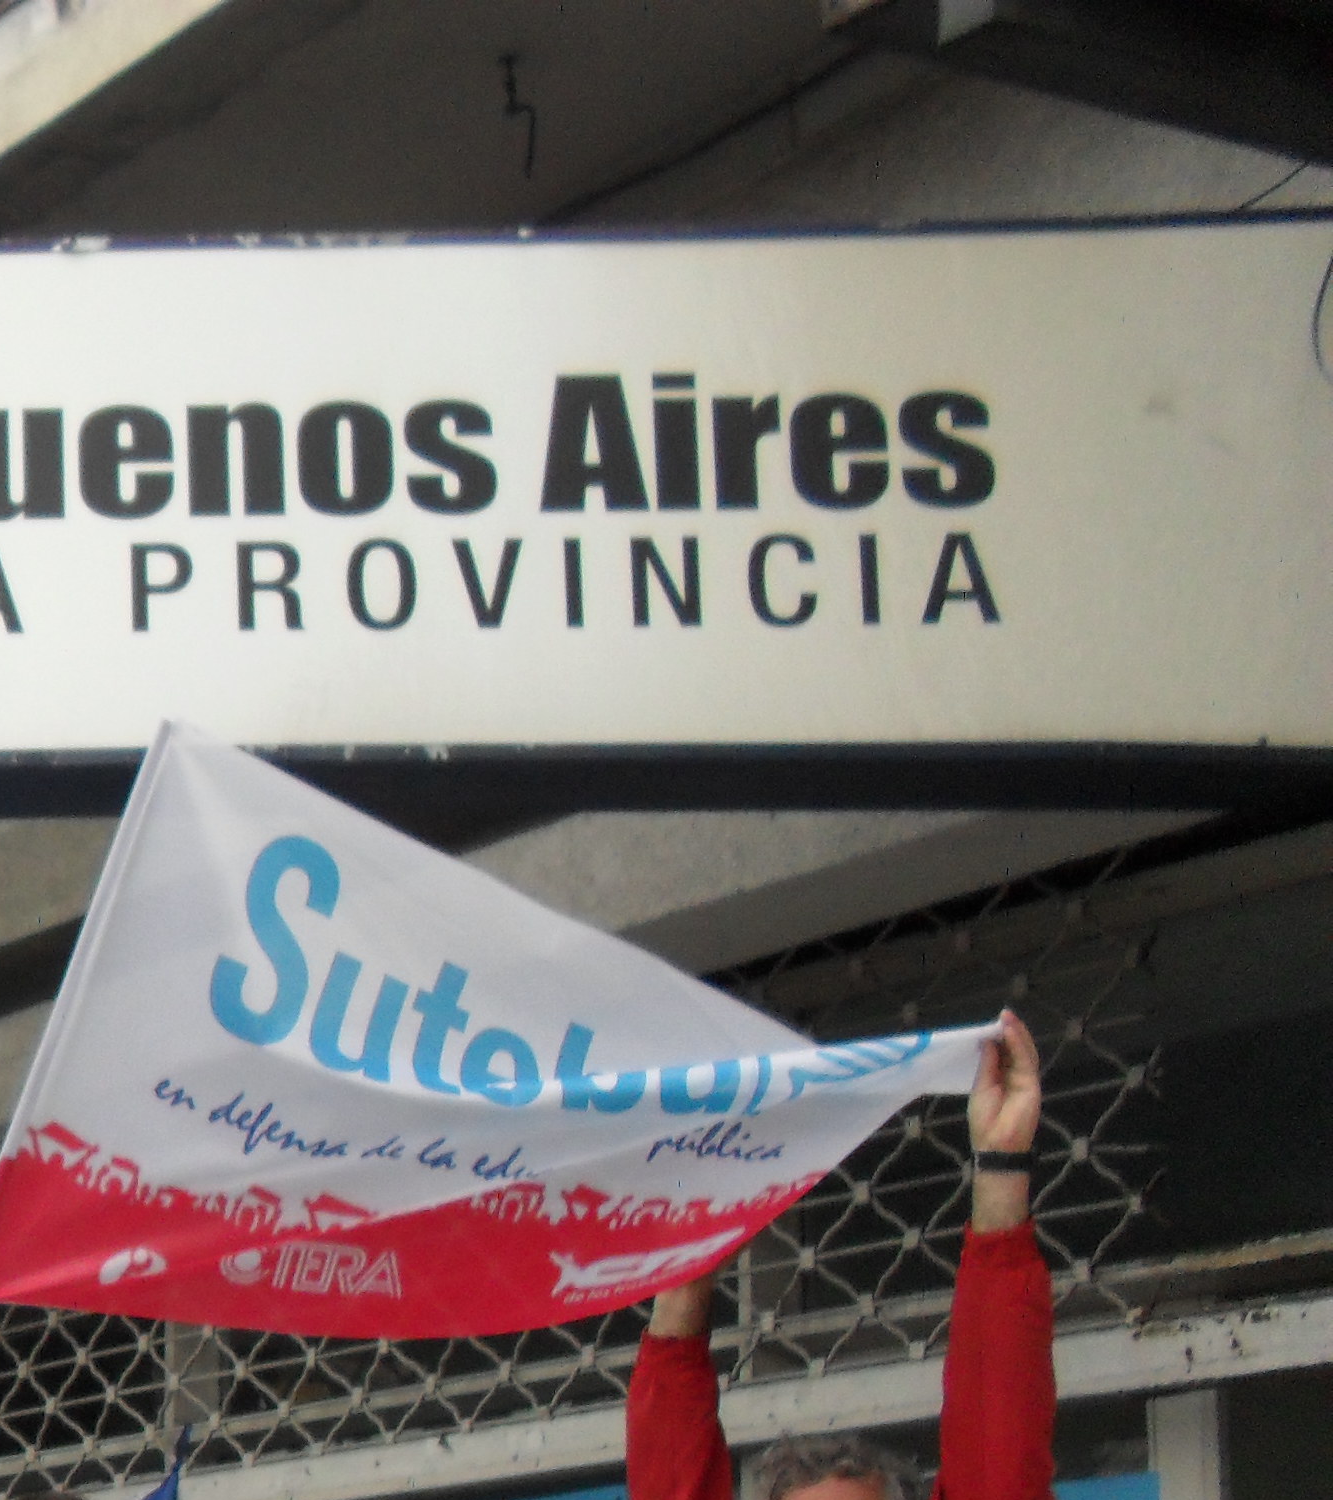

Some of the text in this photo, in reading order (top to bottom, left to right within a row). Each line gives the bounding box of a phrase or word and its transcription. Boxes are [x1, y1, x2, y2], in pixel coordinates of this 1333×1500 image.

[540, 373, 997, 513] Aires
[131, 531, 1002, 634] PROVINCIA
[207, 1091, 349, 1156] defensa
[417, 1137, 458, 1170] la
[646, 1120, 785, 1163] pública
